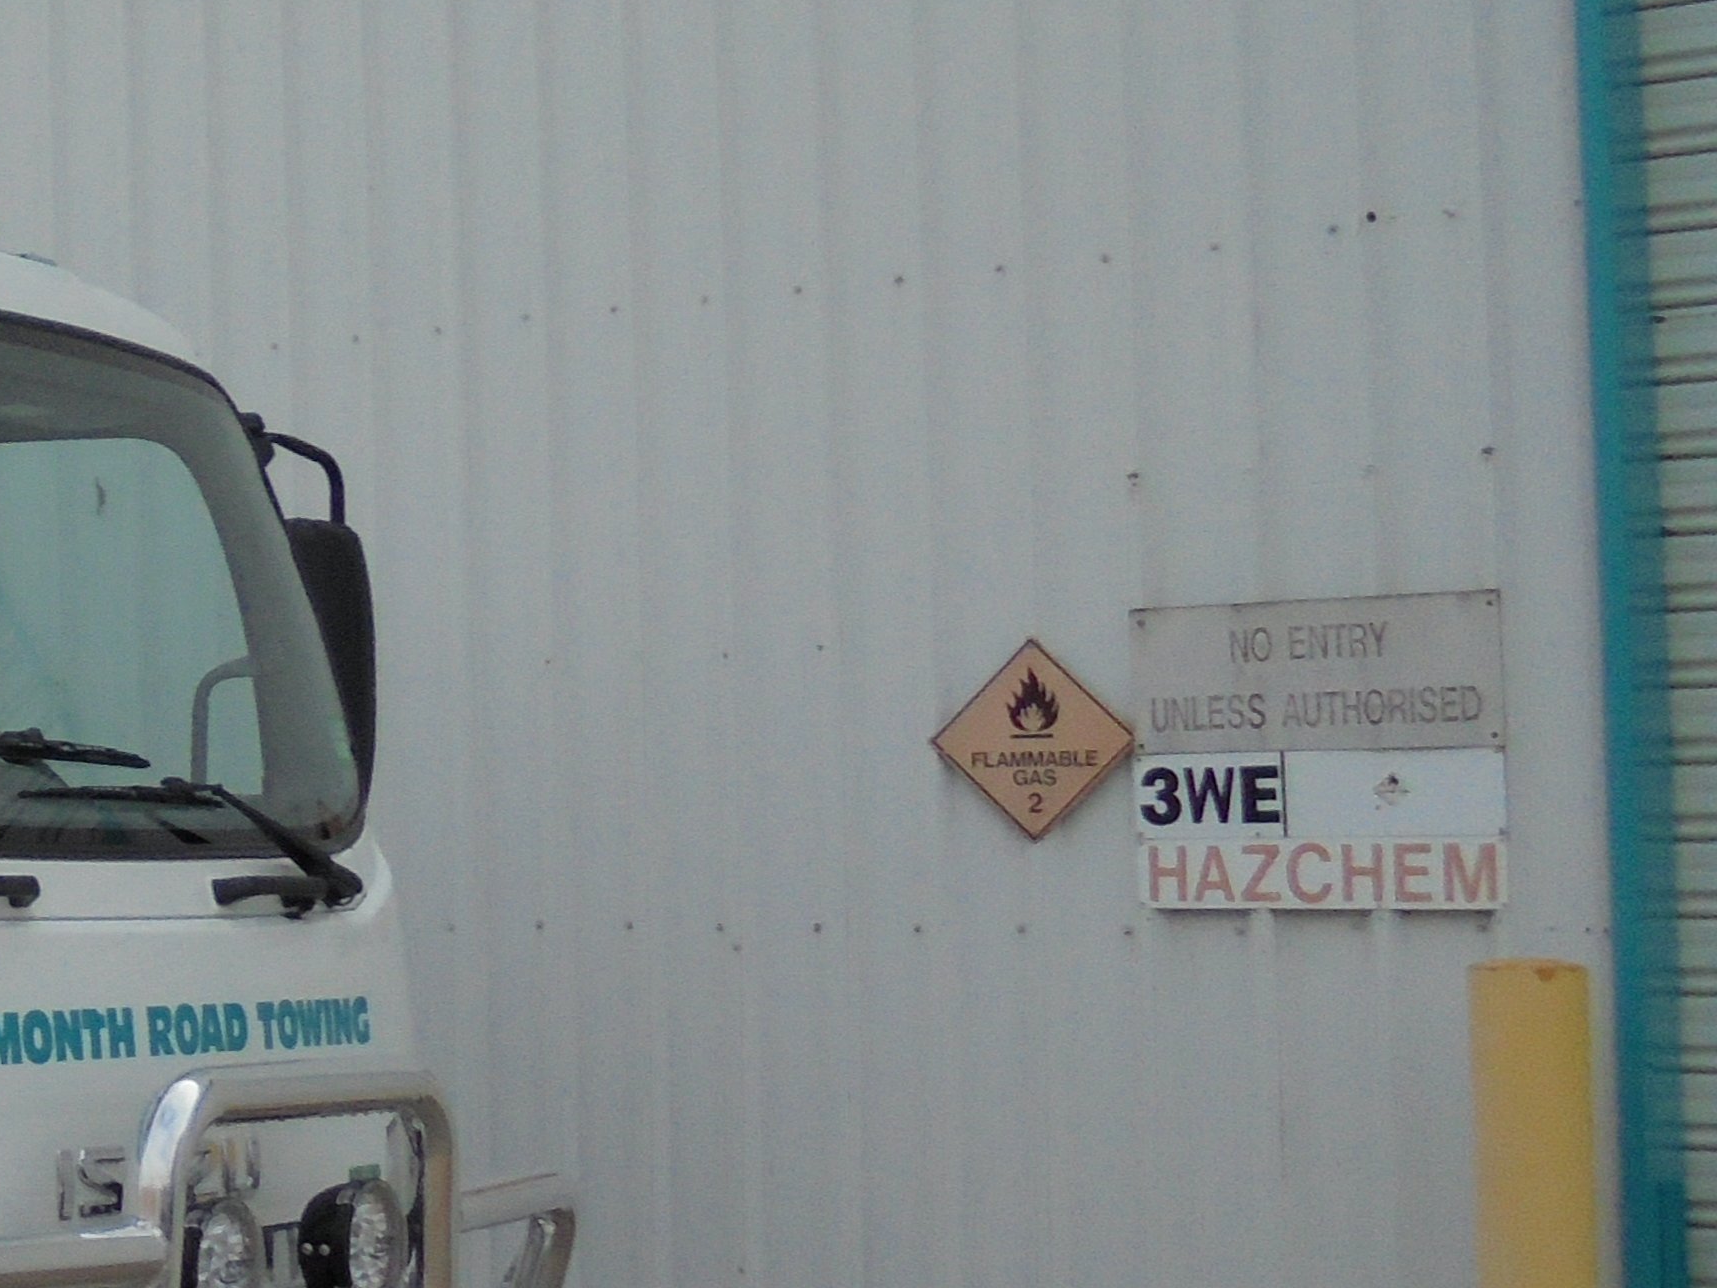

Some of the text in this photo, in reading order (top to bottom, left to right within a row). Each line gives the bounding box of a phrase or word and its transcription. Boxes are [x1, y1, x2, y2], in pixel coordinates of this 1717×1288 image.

[1229, 620, 1389, 663] NO ENTRY
[1150, 685, 1482, 734] UNLESS AUTHORISED
[971, 749, 1098, 770] FLAMMABLE
[1012, 768, 1057, 787] GAS
[1027, 793, 1043, 813] 2
[1140, 765, 1281, 826] 3WE
[1147, 841, 1499, 904] HAZCHEM
[146, 1002, 248, 1057] ROAD
[256, 996, 371, 1050] TOWING
[55, 1134, 262, 1222] ISZU
